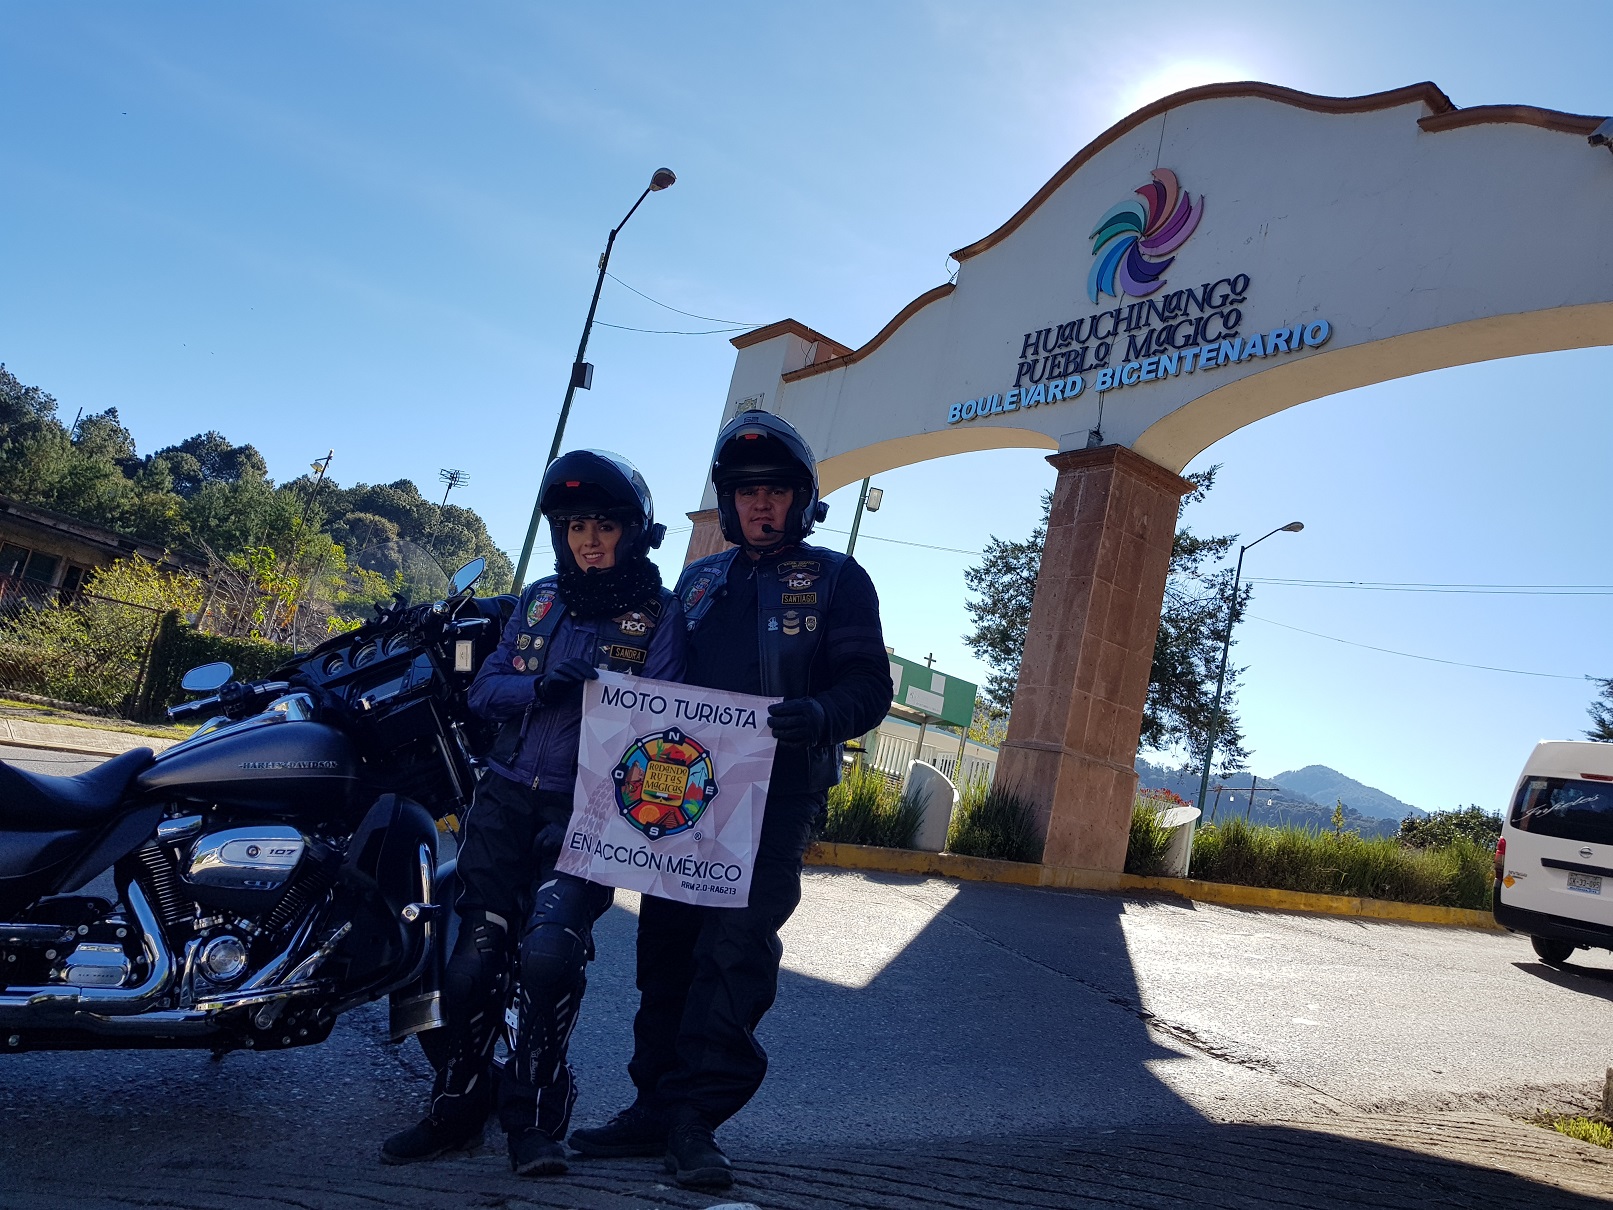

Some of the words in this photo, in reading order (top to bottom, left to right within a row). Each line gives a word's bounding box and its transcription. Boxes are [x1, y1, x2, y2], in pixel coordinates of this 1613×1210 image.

[947, 375, 1085, 424] BOULEVARD
[1095, 319, 1331, 392] BICENTENARIO
[784, 594, 814, 603] SANTIAGO
[615, 648, 641, 661] SANDRA
[601, 685, 666, 714] MOTO
[674, 699, 757, 729] TURISTA
[669, 732, 680, 740] N
[706, 786, 714, 794] E
[650, 827, 659, 836] S
[570, 832, 593, 853] EN
[594, 845, 663, 870] ACCIÓN
[667, 855, 742, 882] MÉXICO
[681, 881, 695, 891] RRM
[695, 883, 737, 895] 2.0-RA6213
